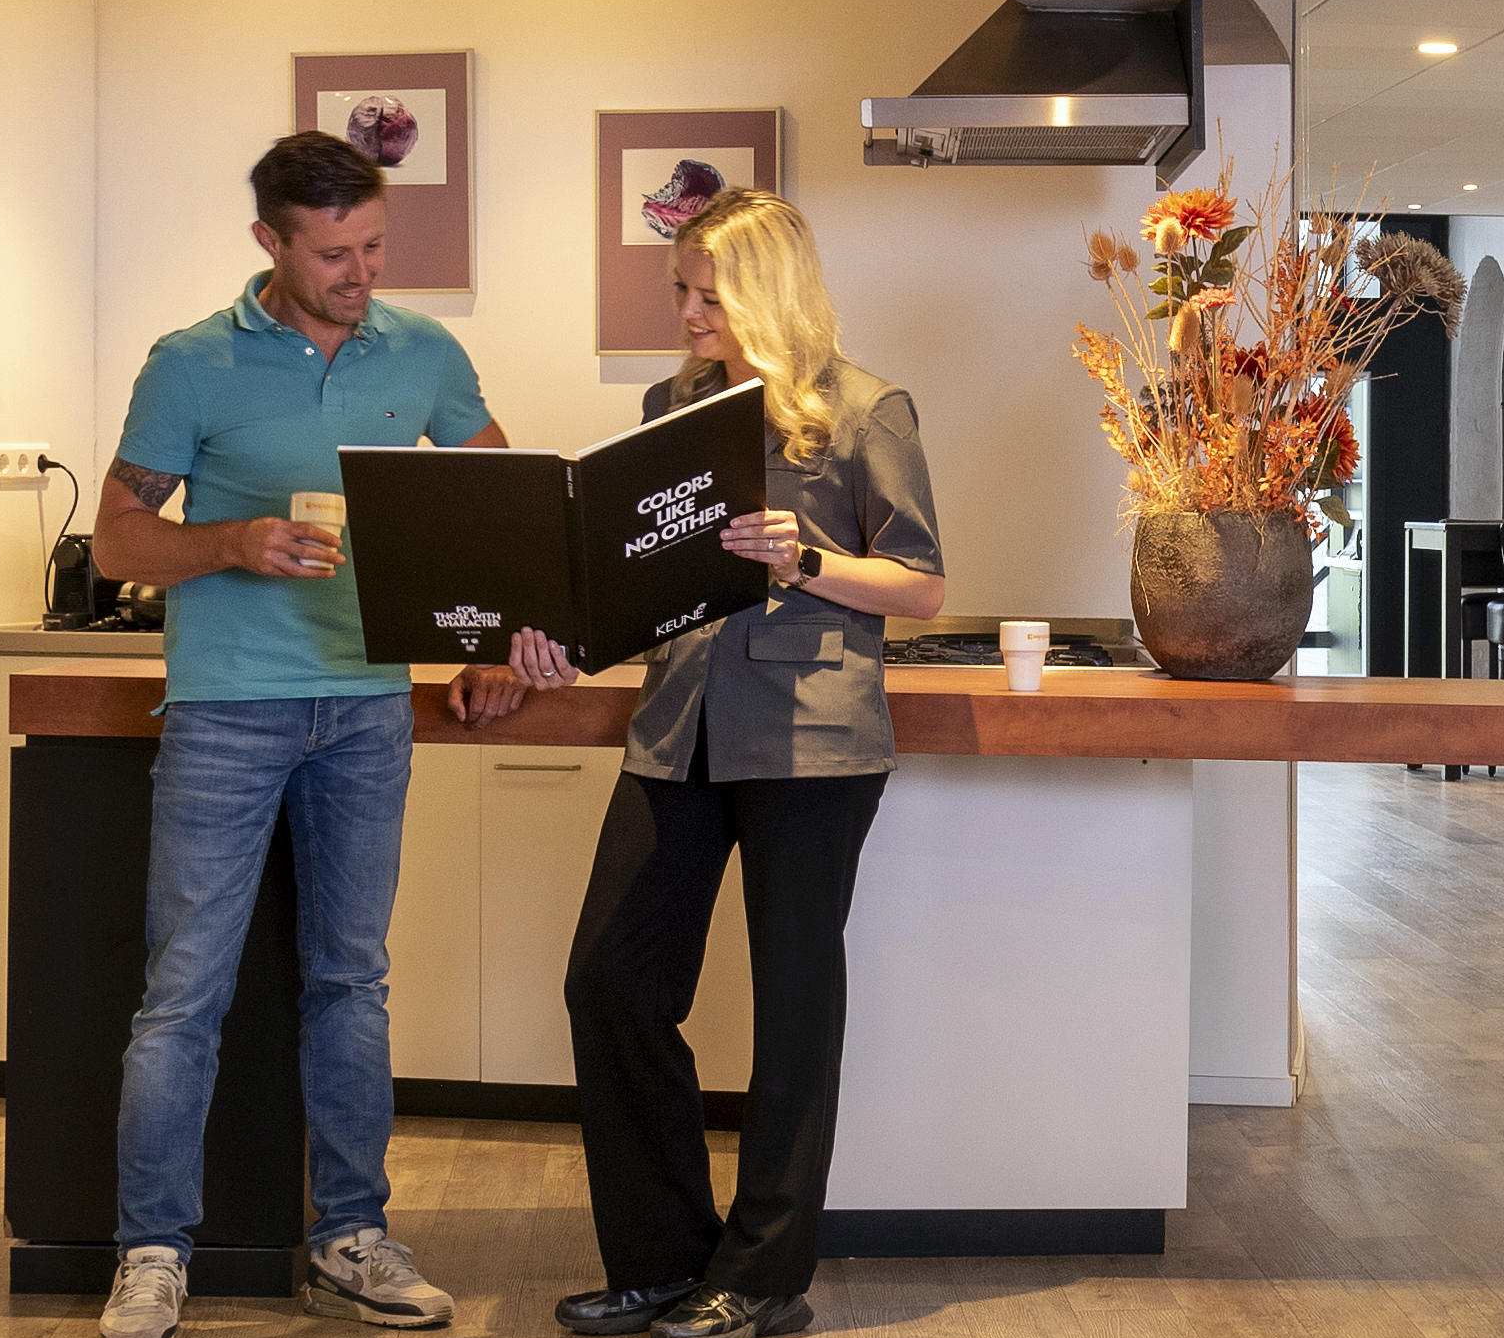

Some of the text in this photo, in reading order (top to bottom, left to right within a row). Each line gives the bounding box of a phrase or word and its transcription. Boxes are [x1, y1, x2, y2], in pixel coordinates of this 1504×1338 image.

[637, 471, 713, 514] COLORS
[656, 496, 696, 527] LIKE
[625, 532, 659, 558] NO
[661, 502, 728, 541] OTHER
[433, 612, 501, 621] THOSE WITH
[436, 619, 502, 628] CHARACTER
[456, 605, 477, 613] FOR
[656, 607, 705, 637] KEUNE
